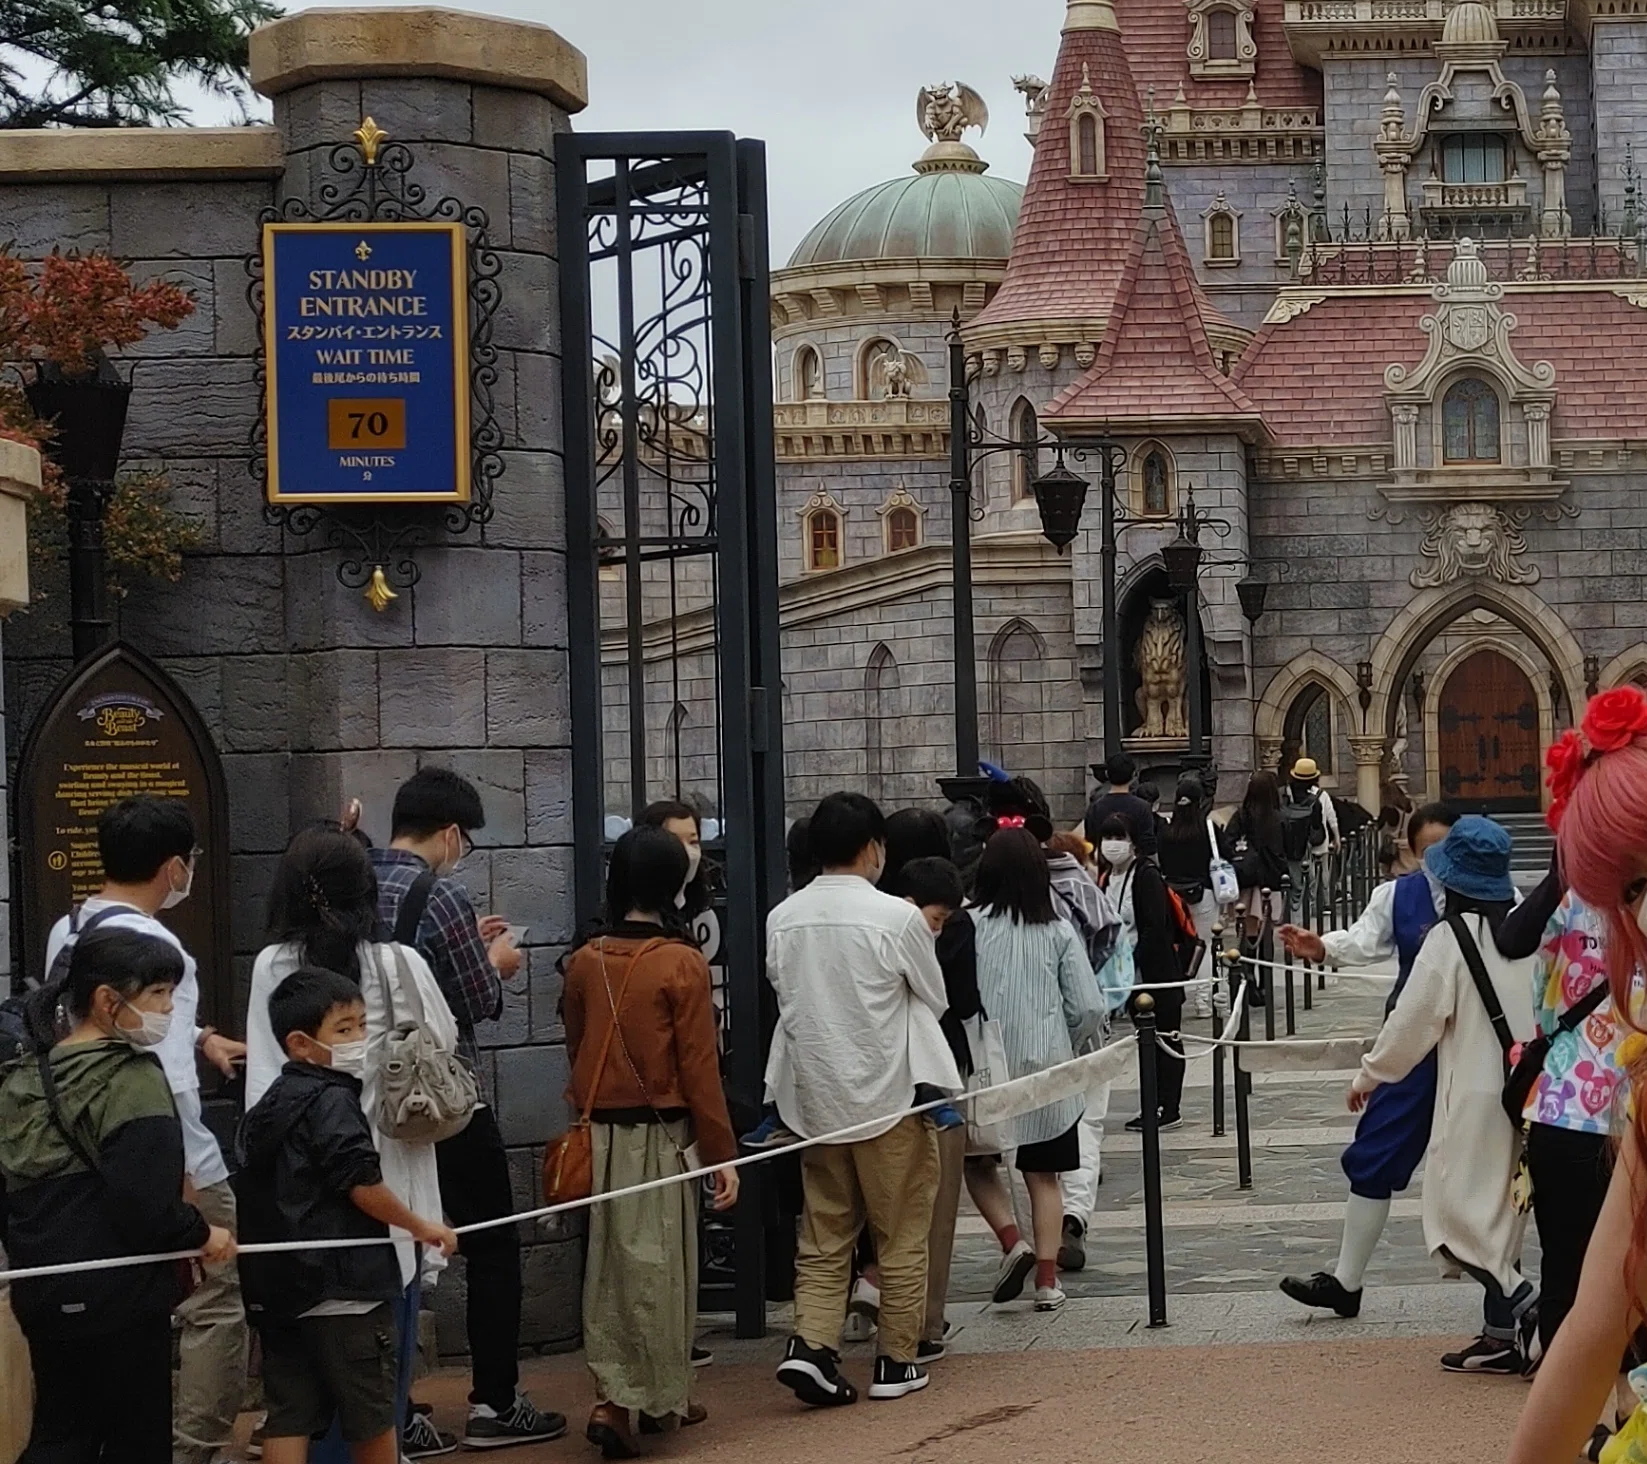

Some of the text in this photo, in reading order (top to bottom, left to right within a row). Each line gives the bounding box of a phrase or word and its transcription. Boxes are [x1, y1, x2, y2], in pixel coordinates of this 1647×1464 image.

[309, 269, 418, 290] STANDBY
[300, 296, 428, 317] ENTRANCE
[288, 325, 442, 340] スタンバイ・エントランス
[316, 349, 414, 365] WAIT TIME
[312, 372, 420, 384] 最後尾からの待ち時間
[348, 412, 388, 438] 70
[339, 456, 395, 468] MINUTES
[363, 471, 372, 481] 分
[97, 708, 145, 726] Beauty
[104, 722, 137, 736] Beast
